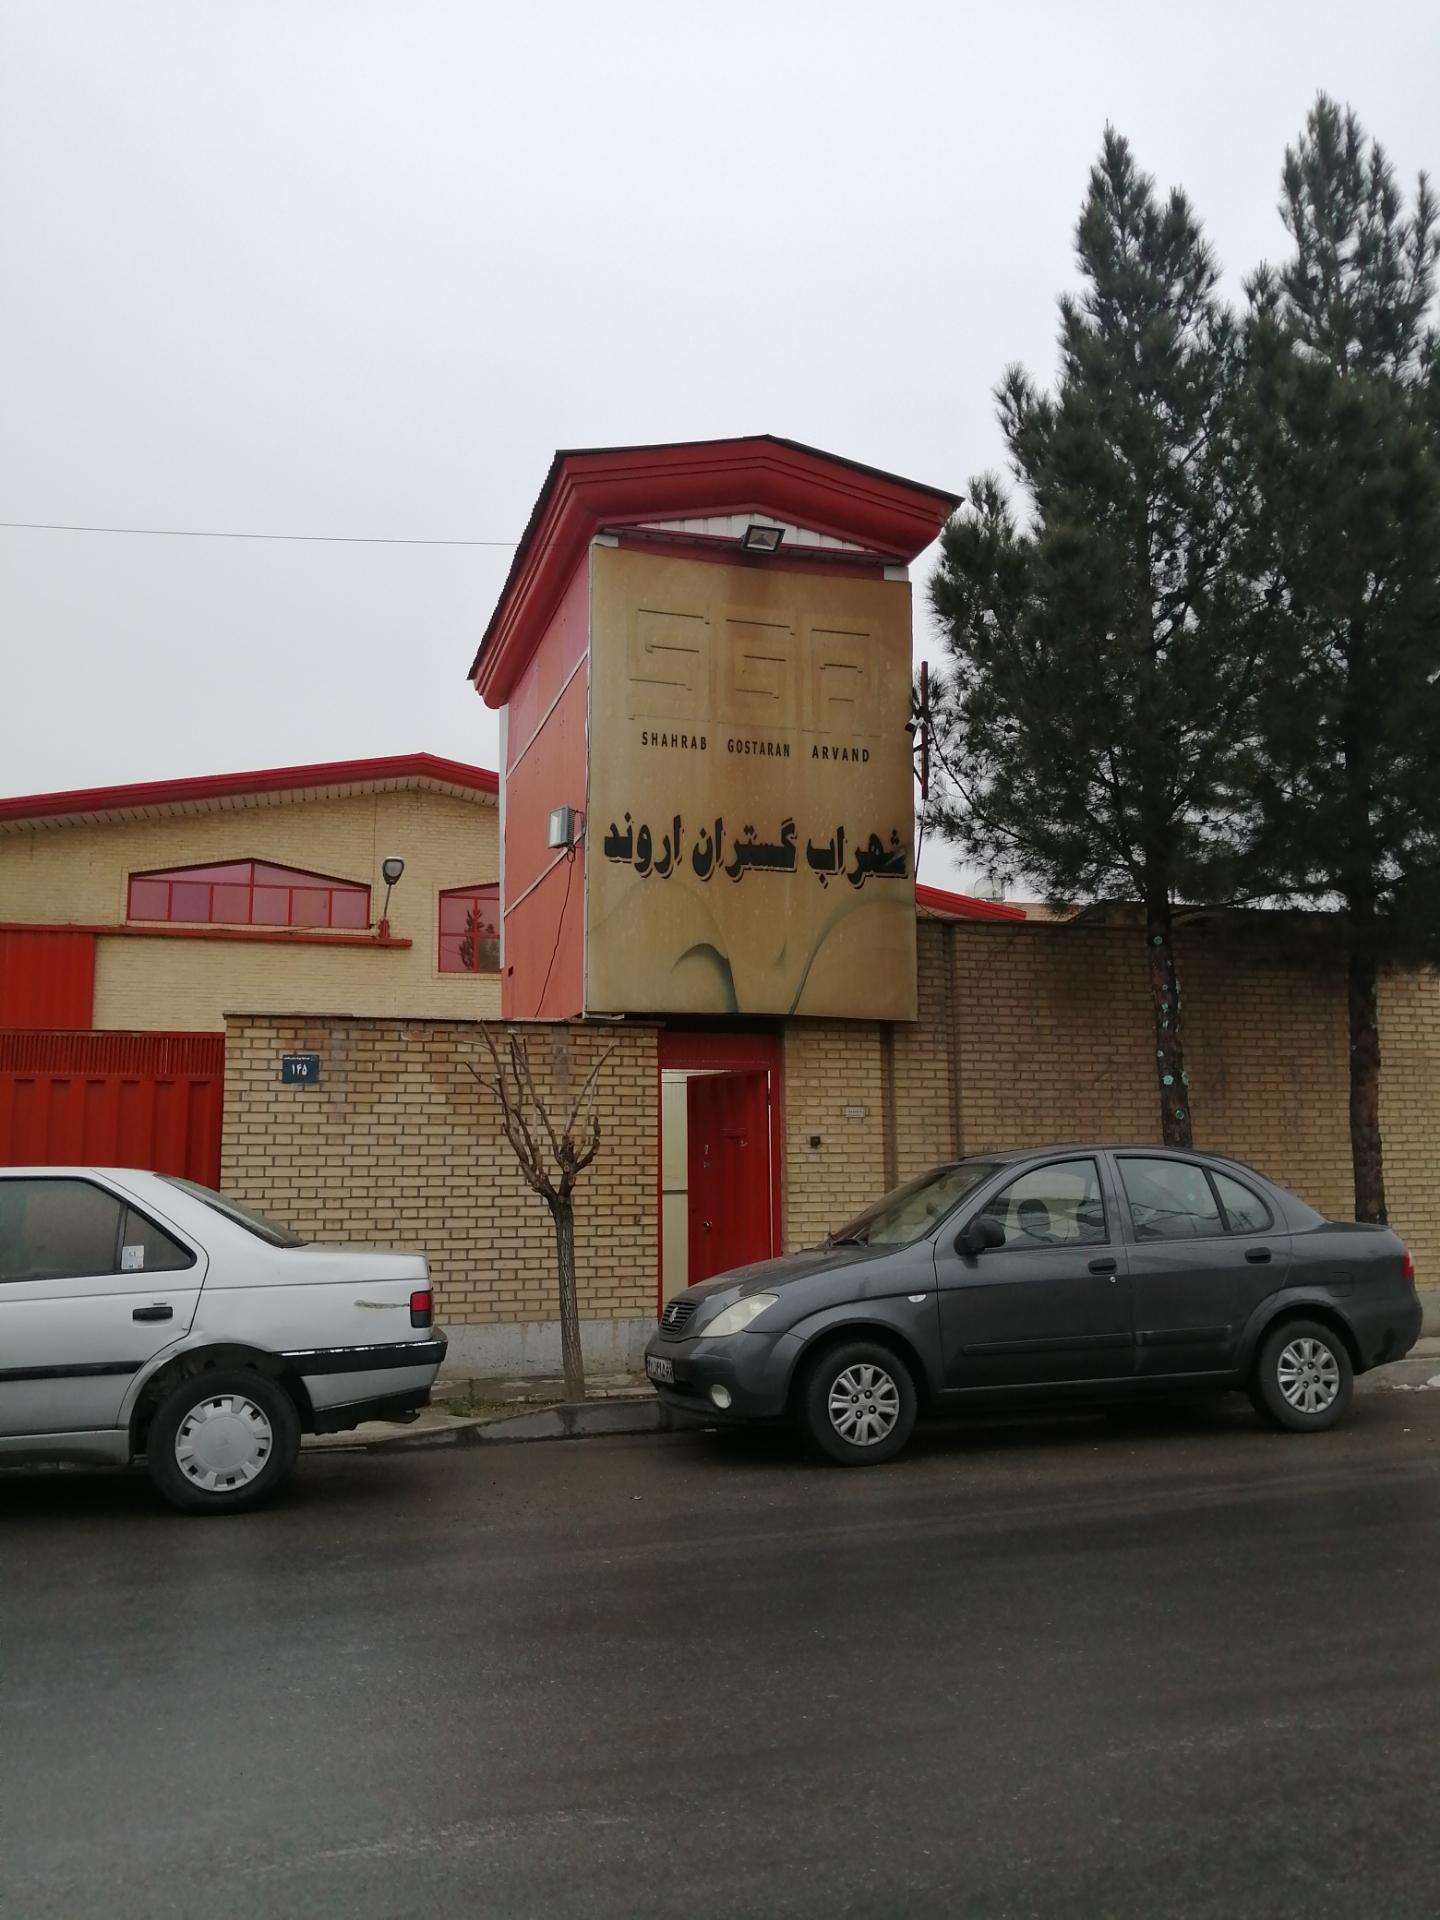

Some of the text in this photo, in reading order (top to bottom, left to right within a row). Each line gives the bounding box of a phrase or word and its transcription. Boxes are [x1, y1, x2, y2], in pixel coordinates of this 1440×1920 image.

[641, 731, 870, 763] SHAHRAB GOSTARAN ARVAND
[603, 811, 909, 889] شهراب گستران اروند
[291, 1063, 308, 1076] ۱۴۵
